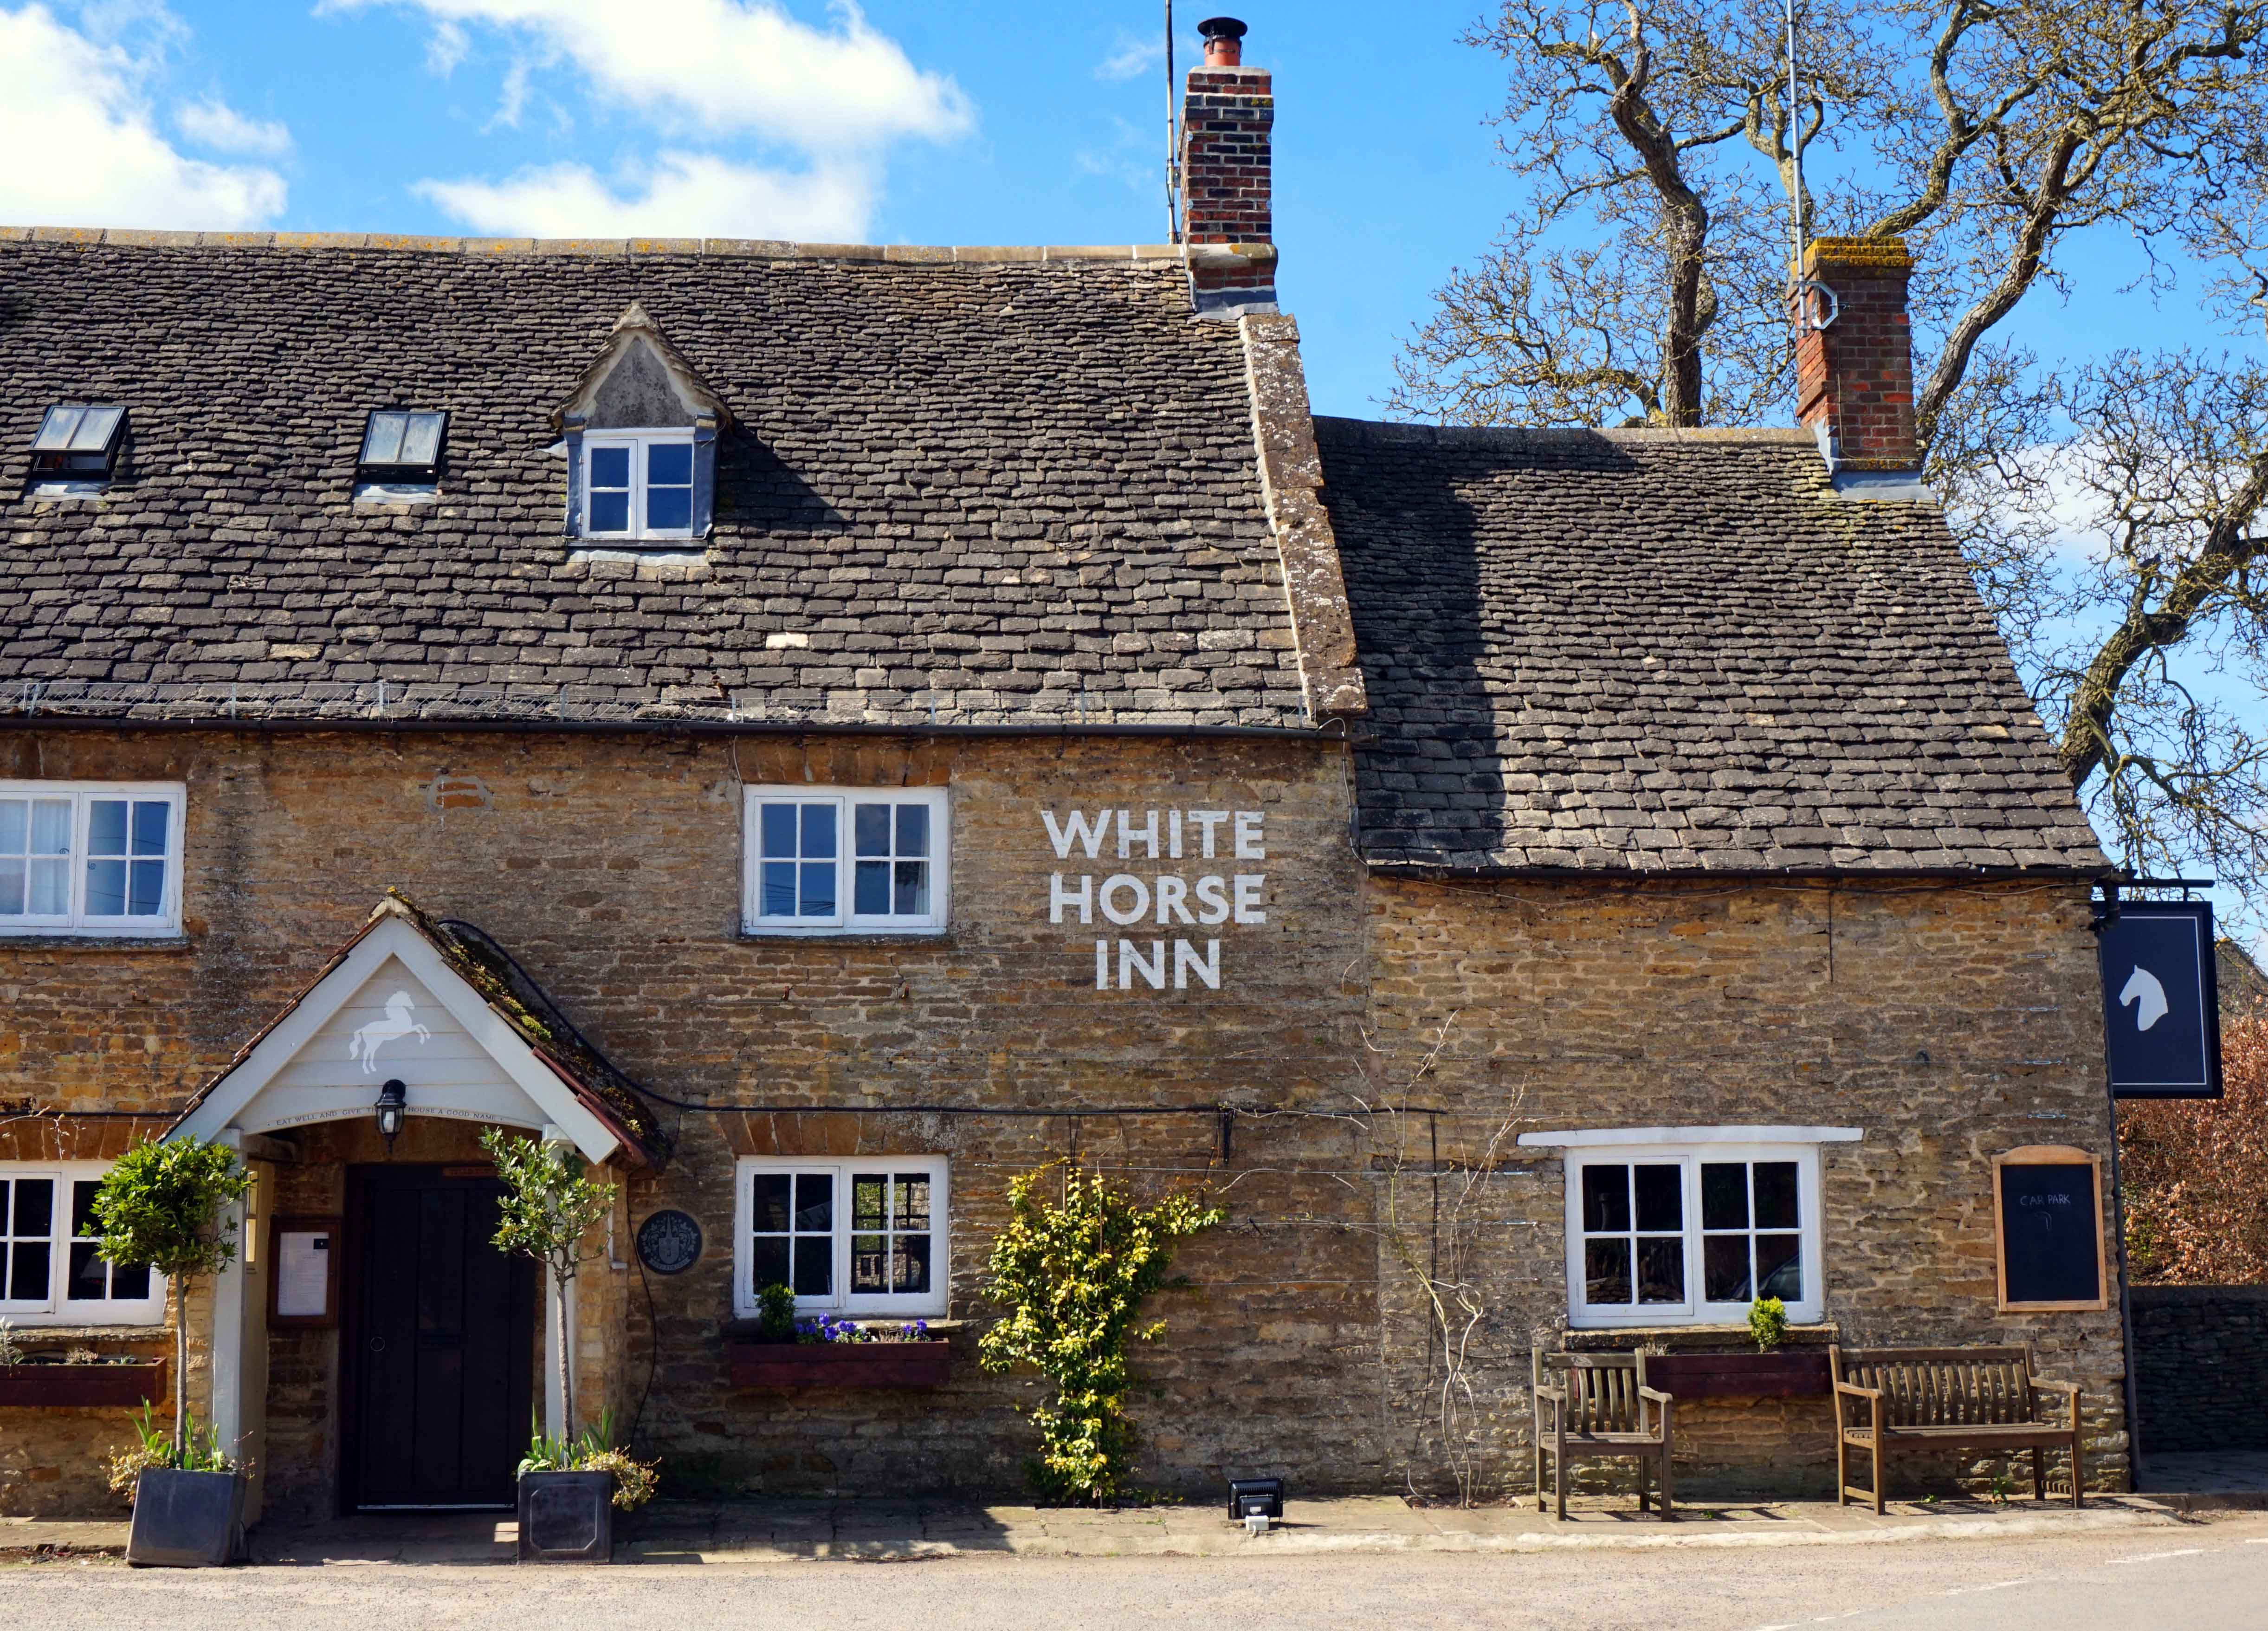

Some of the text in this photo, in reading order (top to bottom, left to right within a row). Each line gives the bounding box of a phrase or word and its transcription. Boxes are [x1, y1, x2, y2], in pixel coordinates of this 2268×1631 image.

[1040, 809, 1266, 860] WHITE
[1050, 874, 1266, 925] HORSE
[1096, 939, 1221, 990] INN
[295, 1113, 317, 1122] WELL
[319, 1110, 337, 1118] AND
[2020, 1193, 2071, 1206] CAR PARK
